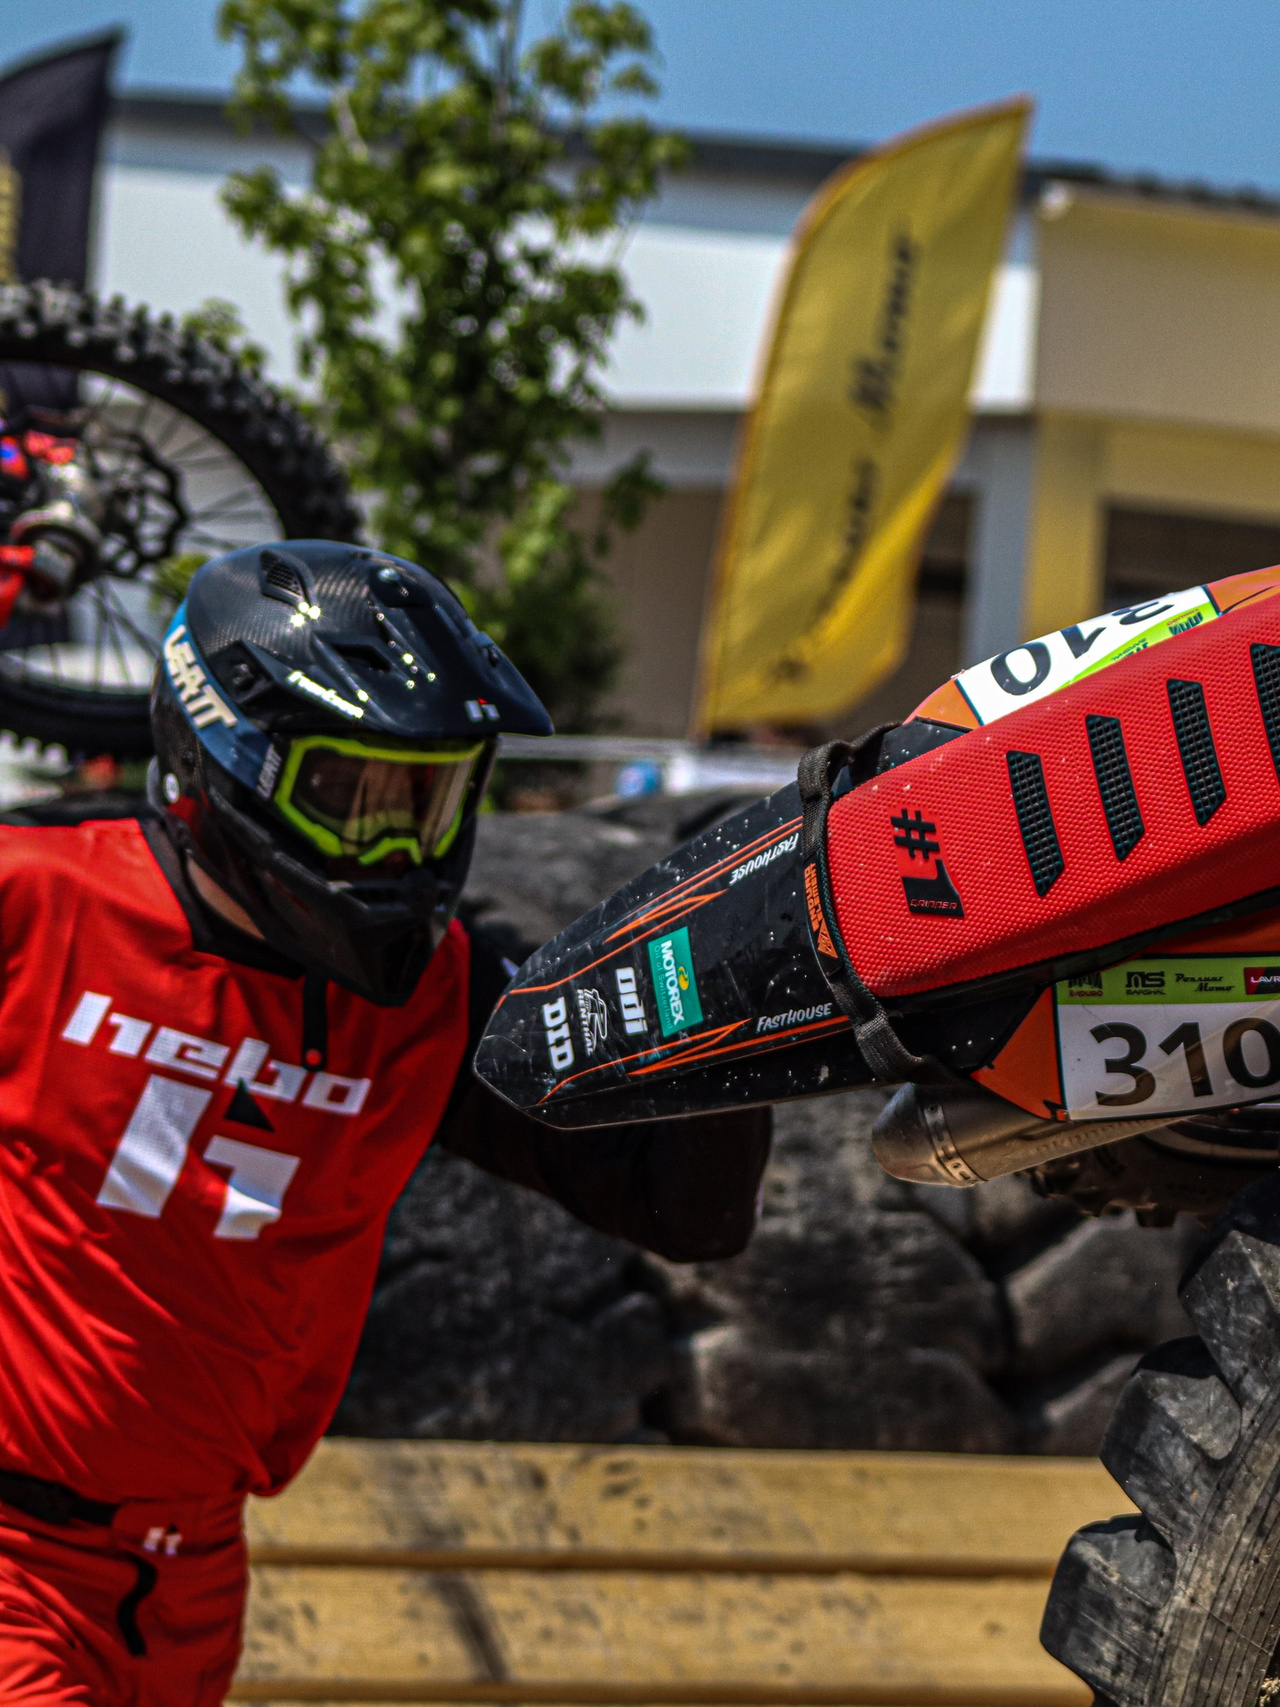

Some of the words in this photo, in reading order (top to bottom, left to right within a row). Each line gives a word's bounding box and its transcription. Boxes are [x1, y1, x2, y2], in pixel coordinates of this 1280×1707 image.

[163, 624, 238, 729] LEATT
[990, 599, 1175, 696] 310
[729, 831, 800, 886] FASTHOUSE
[658, 972, 674, 1030] Switzerland
[660, 940, 686, 1026] MOTOREX
[1068, 988, 1104, 998] ENDURO
[1125, 988, 1166, 996] MARSHAL
[542, 996, 575, 1072] DID
[577, 989, 595, 1057] RENTHAL
[756, 1002, 833, 1033] FASTHOUSE
[62, 990, 371, 1117] hebo
